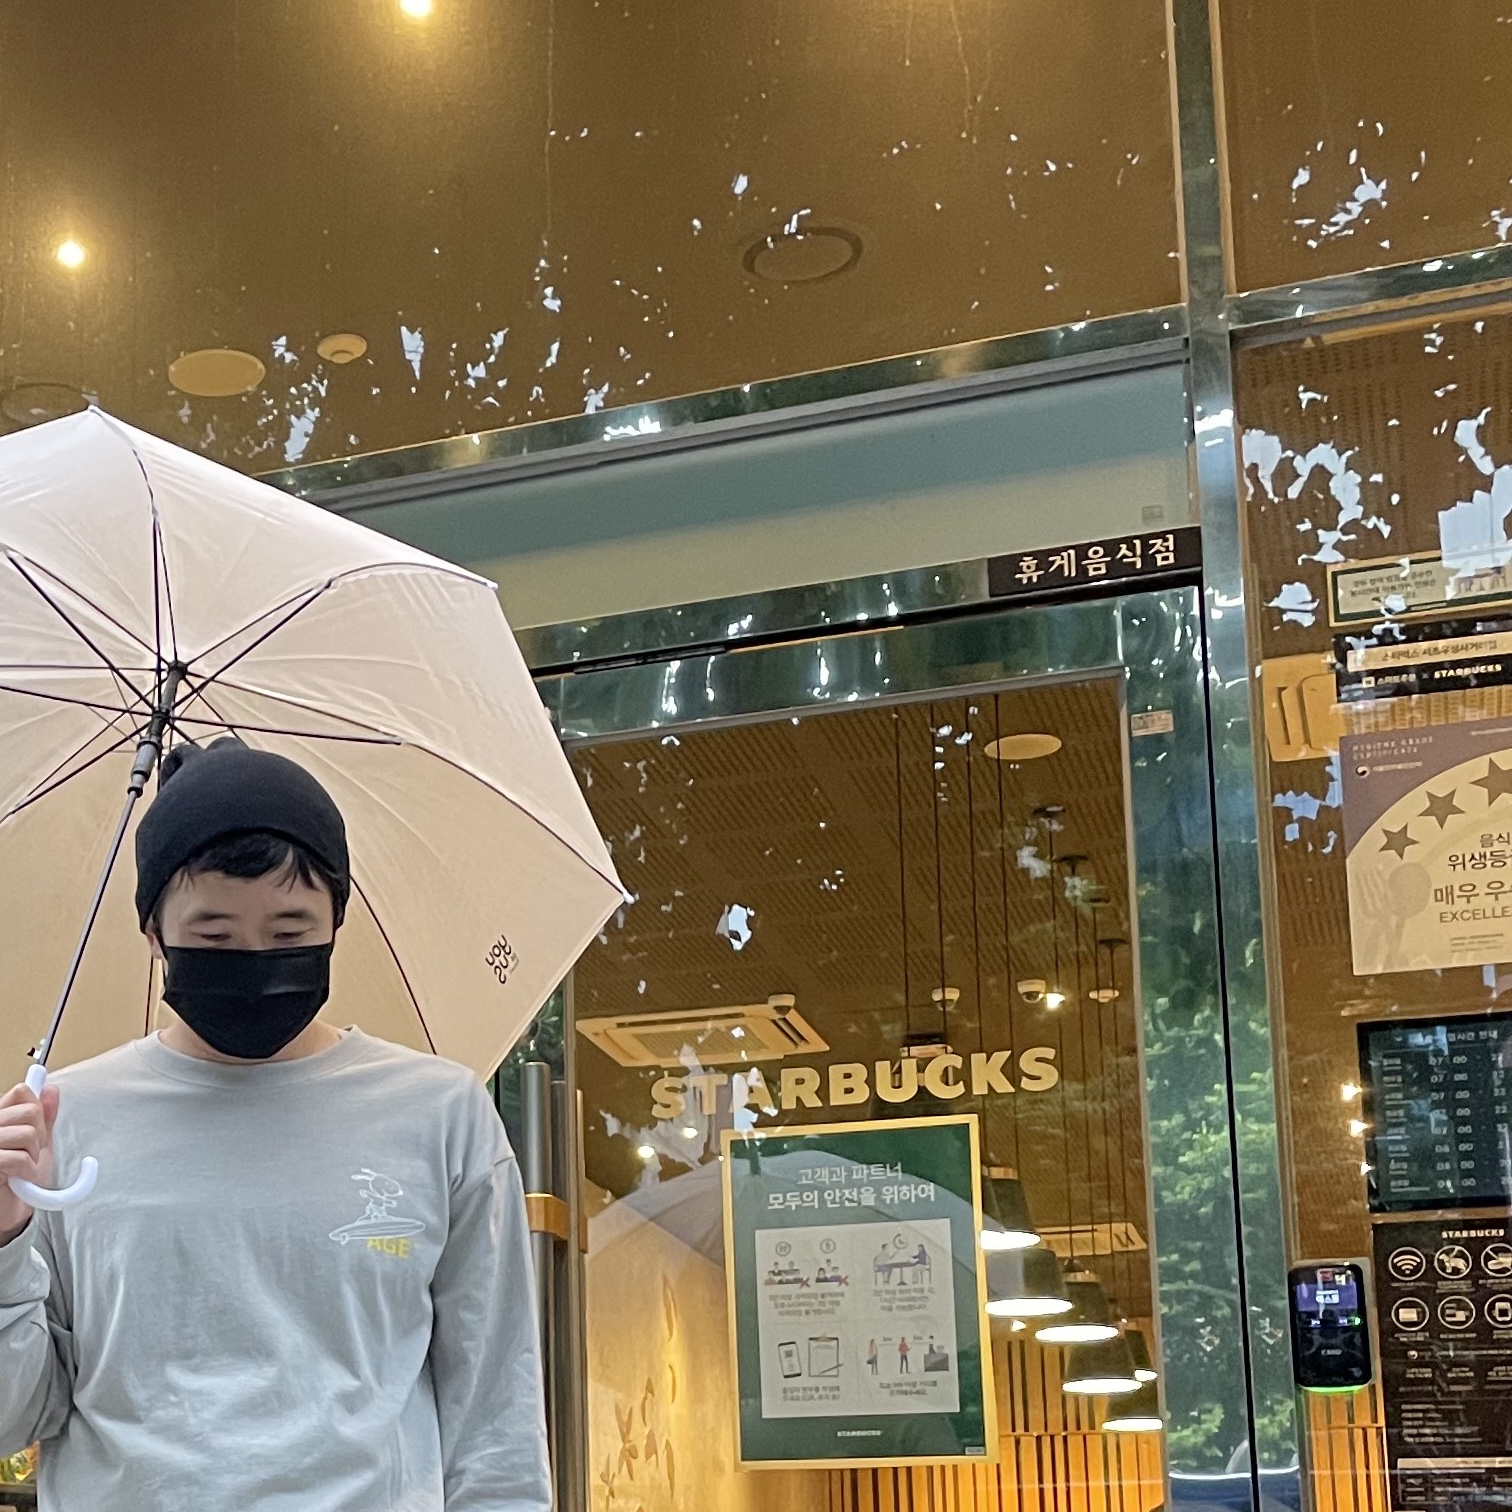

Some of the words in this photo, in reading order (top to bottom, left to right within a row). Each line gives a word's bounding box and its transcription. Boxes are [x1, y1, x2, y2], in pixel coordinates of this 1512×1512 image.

[1014, 534, 1175, 584] 휴게음식점
[1433, 663, 1502, 679] STARBUCKS
[1448, 849, 1512, 872] 위생등
[1433, 882, 1480, 906] 매우
[1484, 880, 1512, 902] 우
[650, 1046, 1060, 1119] STARBUCKS
[796, 1167, 848, 1186] 고객과
[851, 1161, 903, 1182] 파트너
[766, 1191, 820, 1211] 모두의
[823, 1187, 878, 1209] 안전을
[881, 1182, 936, 1204] 위하여
[1442, 1228, 1505, 1239] STARBUCKS
